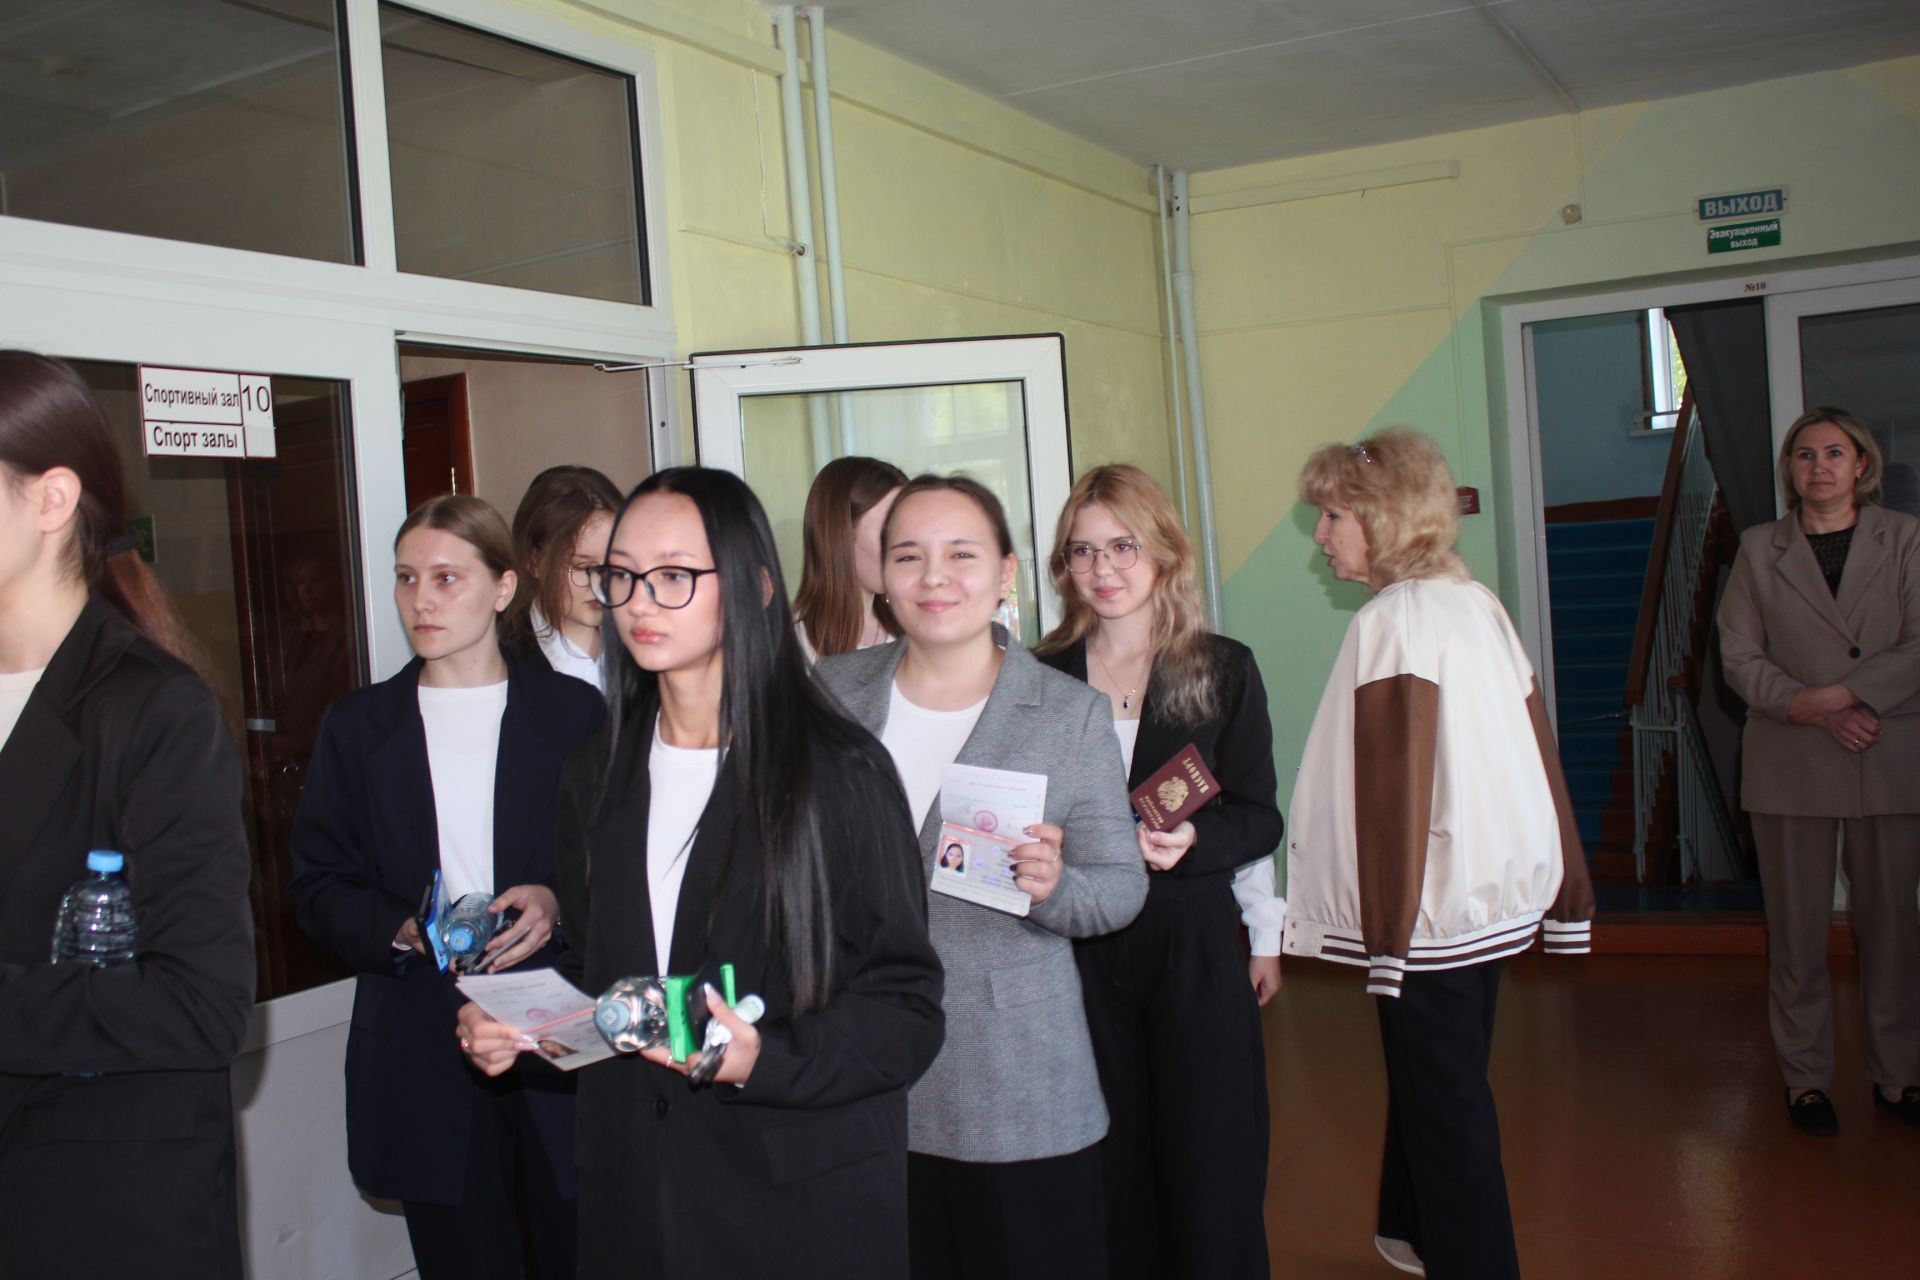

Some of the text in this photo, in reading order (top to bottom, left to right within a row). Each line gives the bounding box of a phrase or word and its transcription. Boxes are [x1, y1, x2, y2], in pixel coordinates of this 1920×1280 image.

[1704, 193, 1777, 217] ВЫХОД
[1709, 222, 1778, 239] Эвакуационный
[1730, 238, 1758, 249] выход
[1744, 282, 1766, 292] №10
[144, 383, 240, 408] Спортивный зал
[242, 385, 270, 412] 10
[153, 426, 238, 452] Спорт залы
